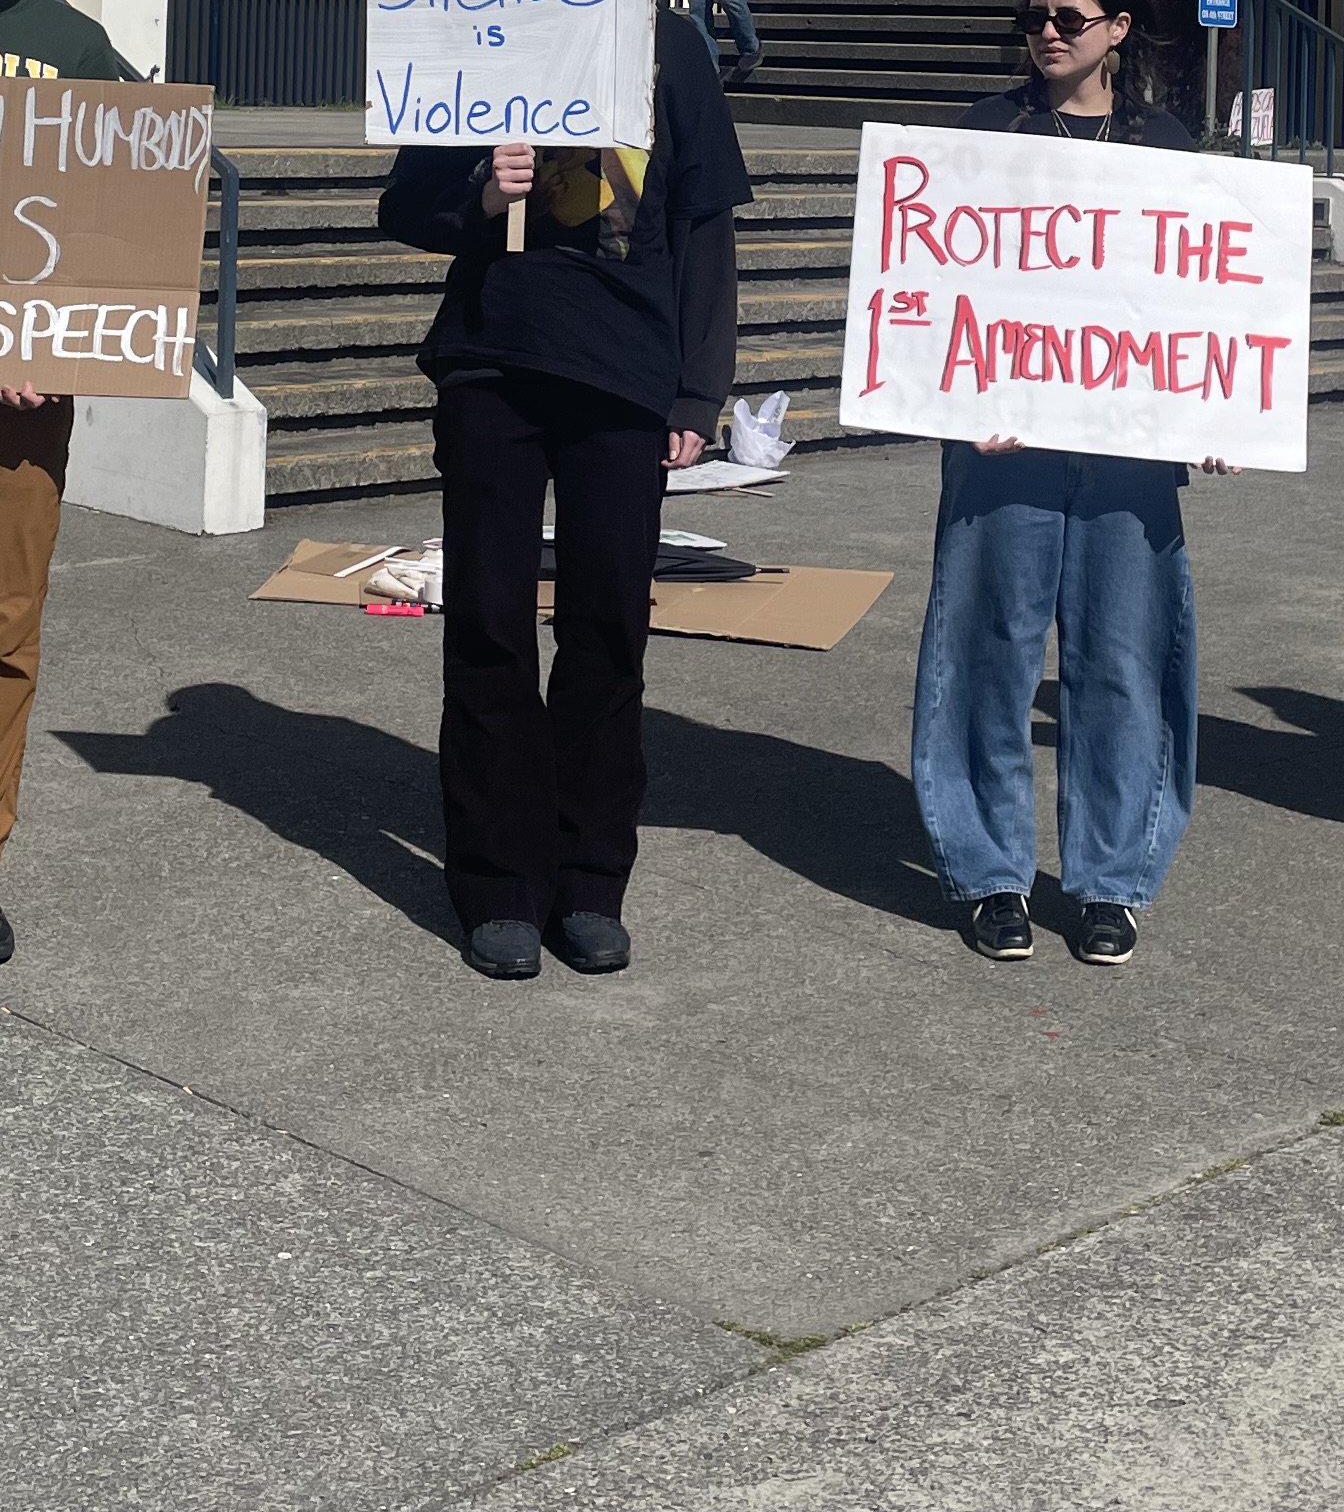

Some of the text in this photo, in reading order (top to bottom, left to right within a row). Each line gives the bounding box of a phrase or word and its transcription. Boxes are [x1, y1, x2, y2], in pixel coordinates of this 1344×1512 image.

[472, 25, 505, 47] is
[23, 86, 214, 196] HUMBOLDT
[376, 61, 601, 136] Violence
[880, 155, 1122, 274] PROTECT
[1142, 209, 1264, 285] THE
[939, 294, 1293, 414] AMENDMENT
